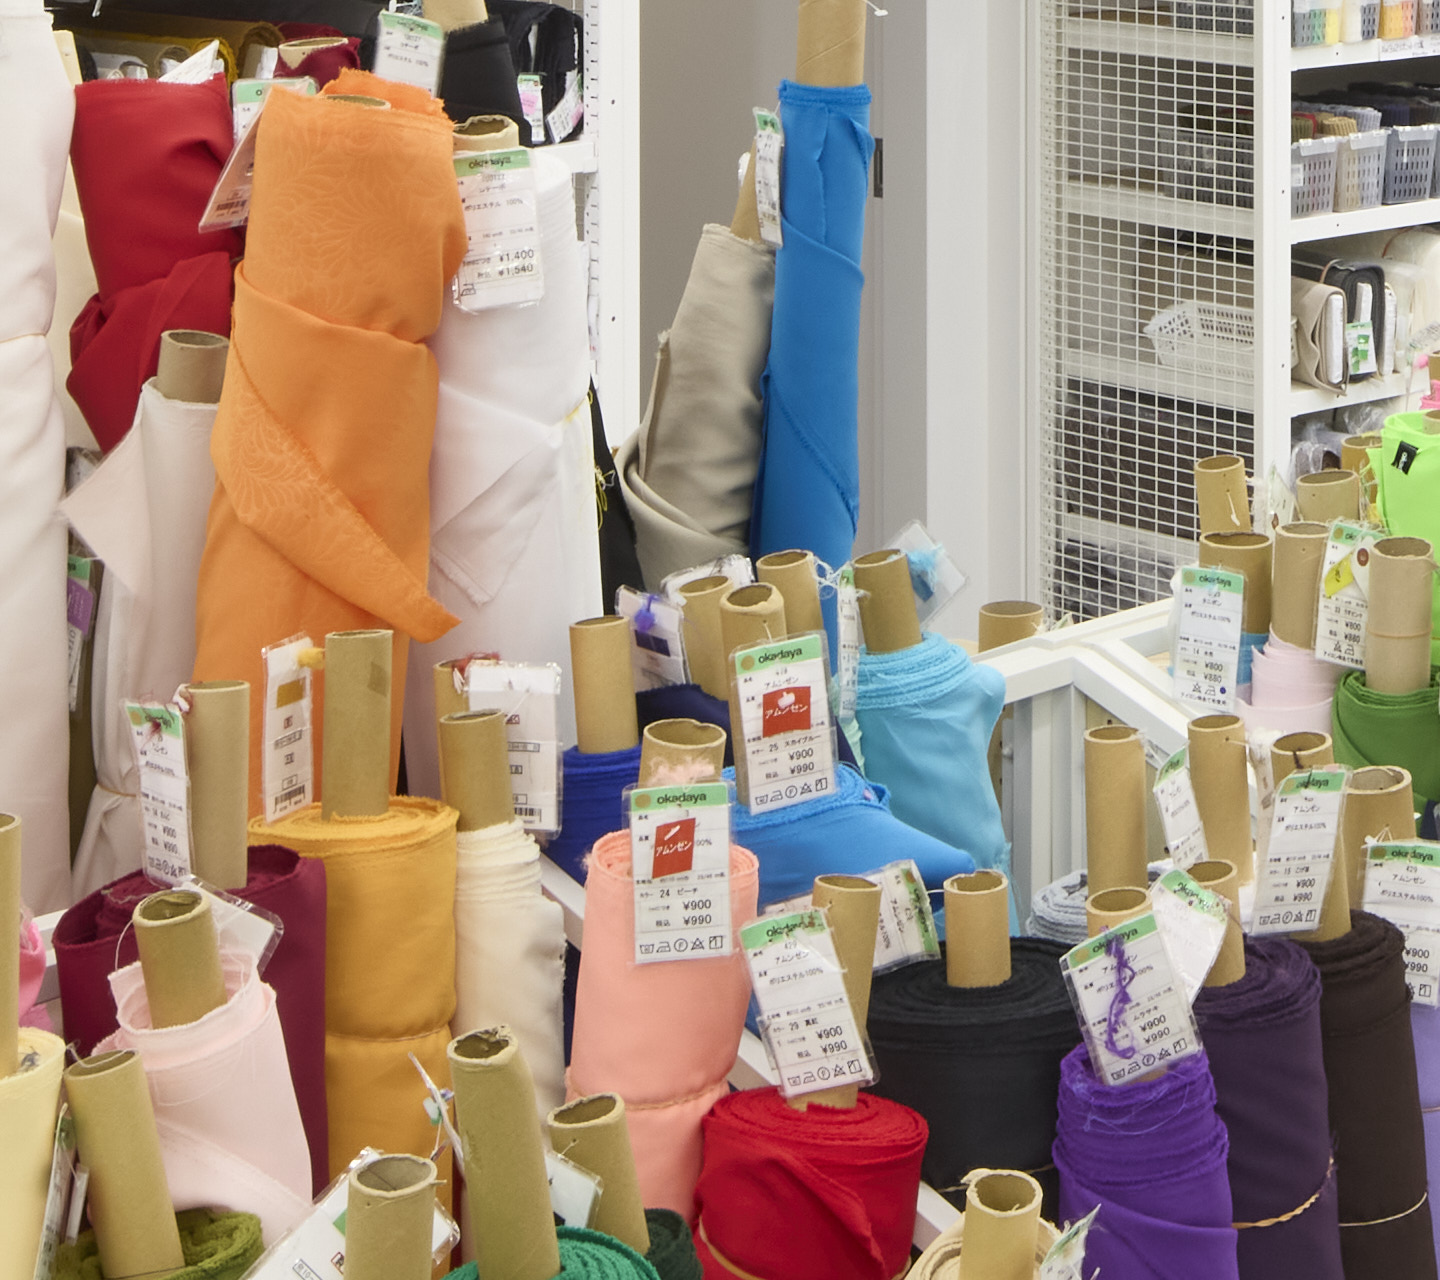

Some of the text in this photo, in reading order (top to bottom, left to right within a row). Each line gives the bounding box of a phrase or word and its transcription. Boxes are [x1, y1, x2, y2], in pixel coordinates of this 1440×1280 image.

[499, 249, 534, 262] ¥1,400
[498, 263, 534, 276] ¥1,540
[1345, 623, 1361, 631] ¥800
[1344, 634, 1360, 643] ¥880
[758, 646, 803, 663] okadaya
[1205, 662, 1223, 672] ¥800
[1204, 674, 1222, 683] ¥880
[765, 702, 808, 719] アムンゼン
[769, 743, 779, 752] 25
[788, 748, 814, 761] ¥900
[789, 762, 815, 775] ¥990
[656, 791, 707, 805] okadaya
[656, 840, 692, 856] アムンゼン
[1296, 878, 1316, 888] ¥900
[1392, 873, 1426, 885] アムンゼン
[660, 889, 670, 898] 24
[1293, 892, 1313, 902] ¥990
[683, 899, 711, 911] ¥900
[683, 914, 712, 926] ¥990
[1140, 1014, 1167, 1032] ¥900
[816, 1026, 843, 1039] ¥900
[1143, 1027, 1170, 1044] ¥990
[820, 1040, 848, 1054] ¥990
